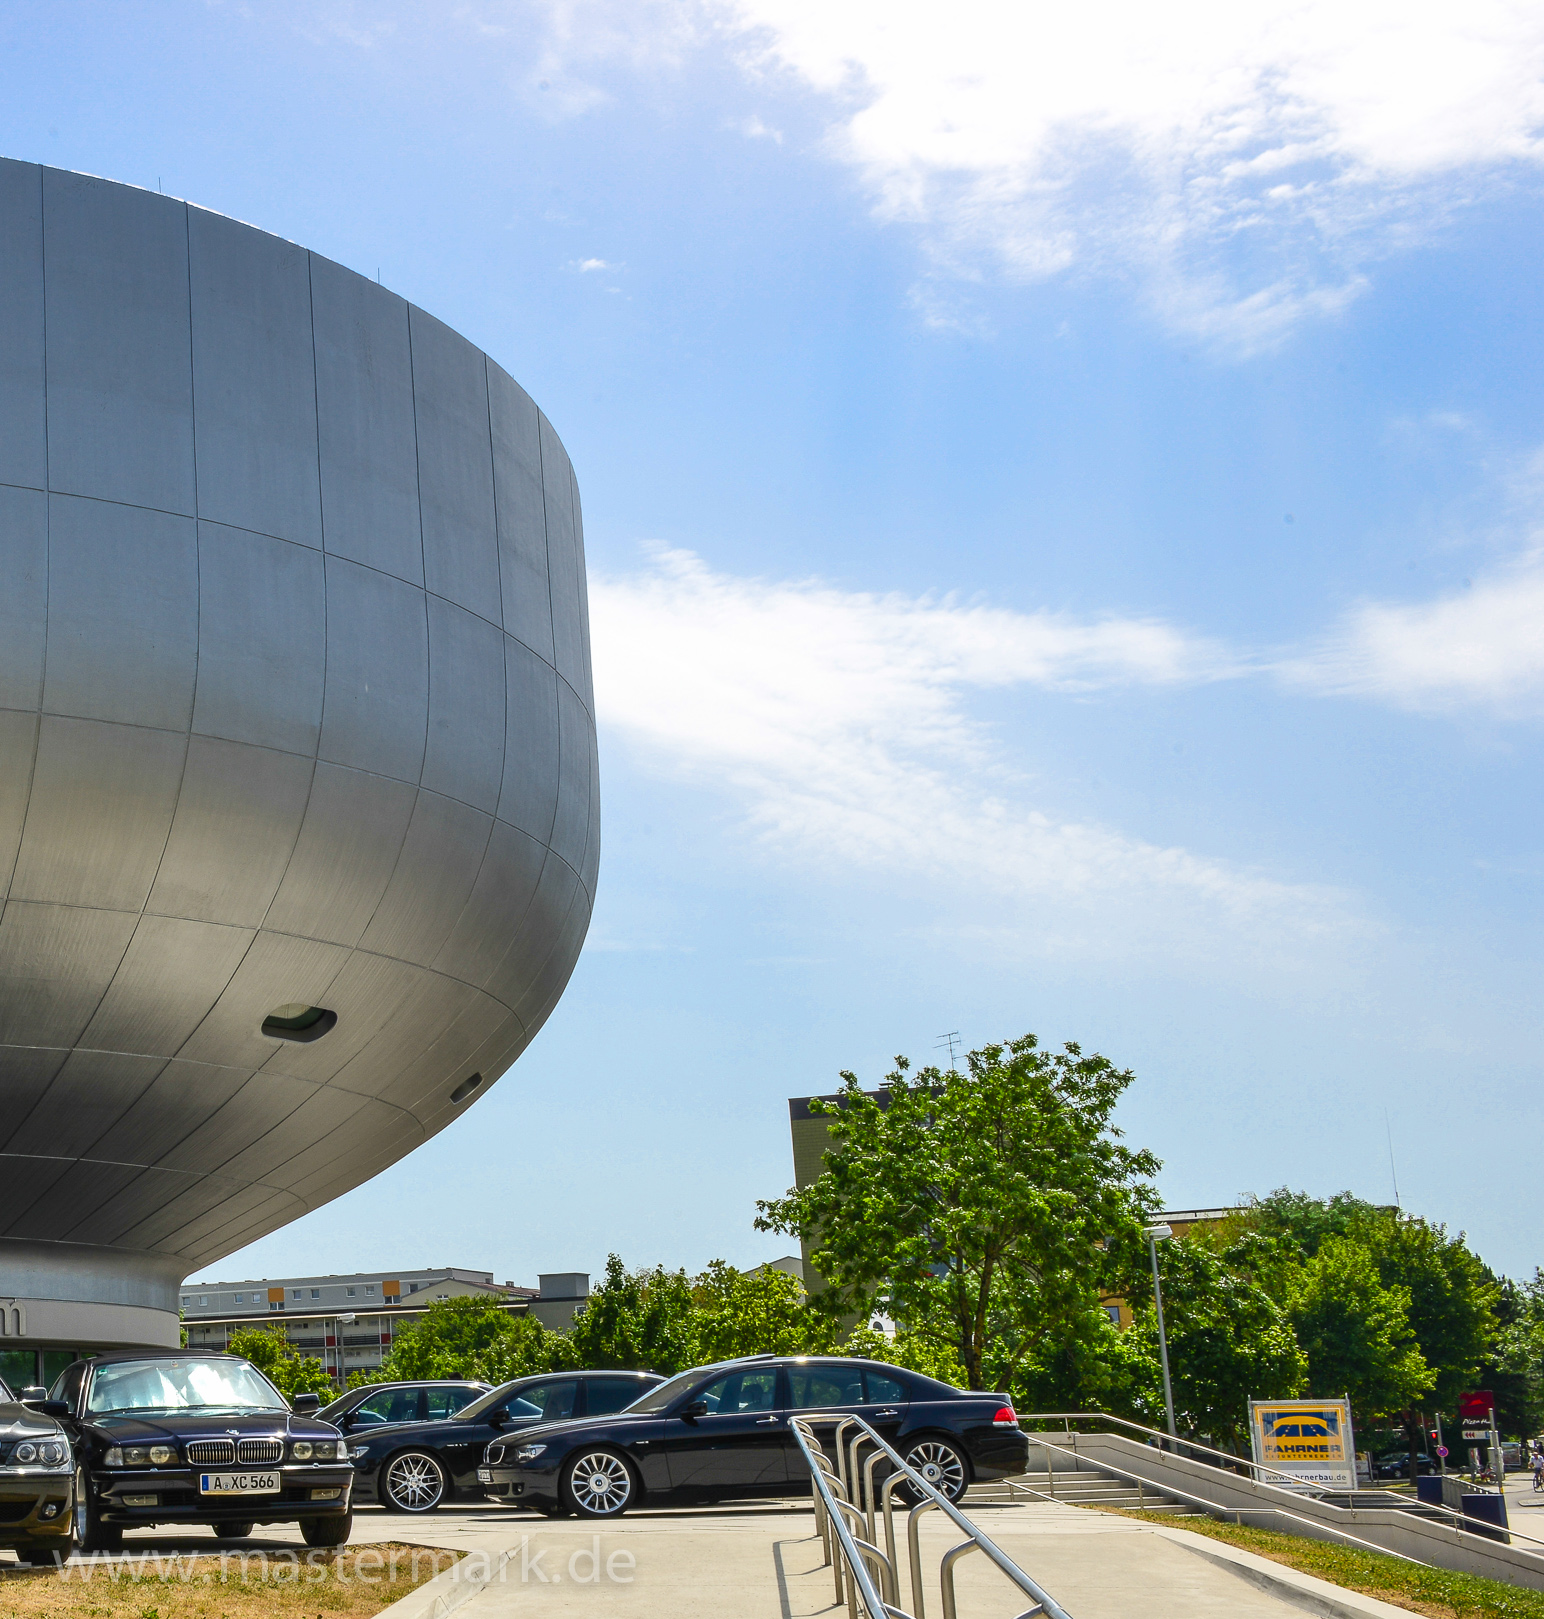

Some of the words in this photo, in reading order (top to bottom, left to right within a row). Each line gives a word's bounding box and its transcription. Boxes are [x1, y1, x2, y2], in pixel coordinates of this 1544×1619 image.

[1265, 1444, 1341, 1453] FAHRNER
[214, 1477, 222, 1489] A
[231, 1476, 248, 1489] XC
[250, 1475, 274, 1489] 566
